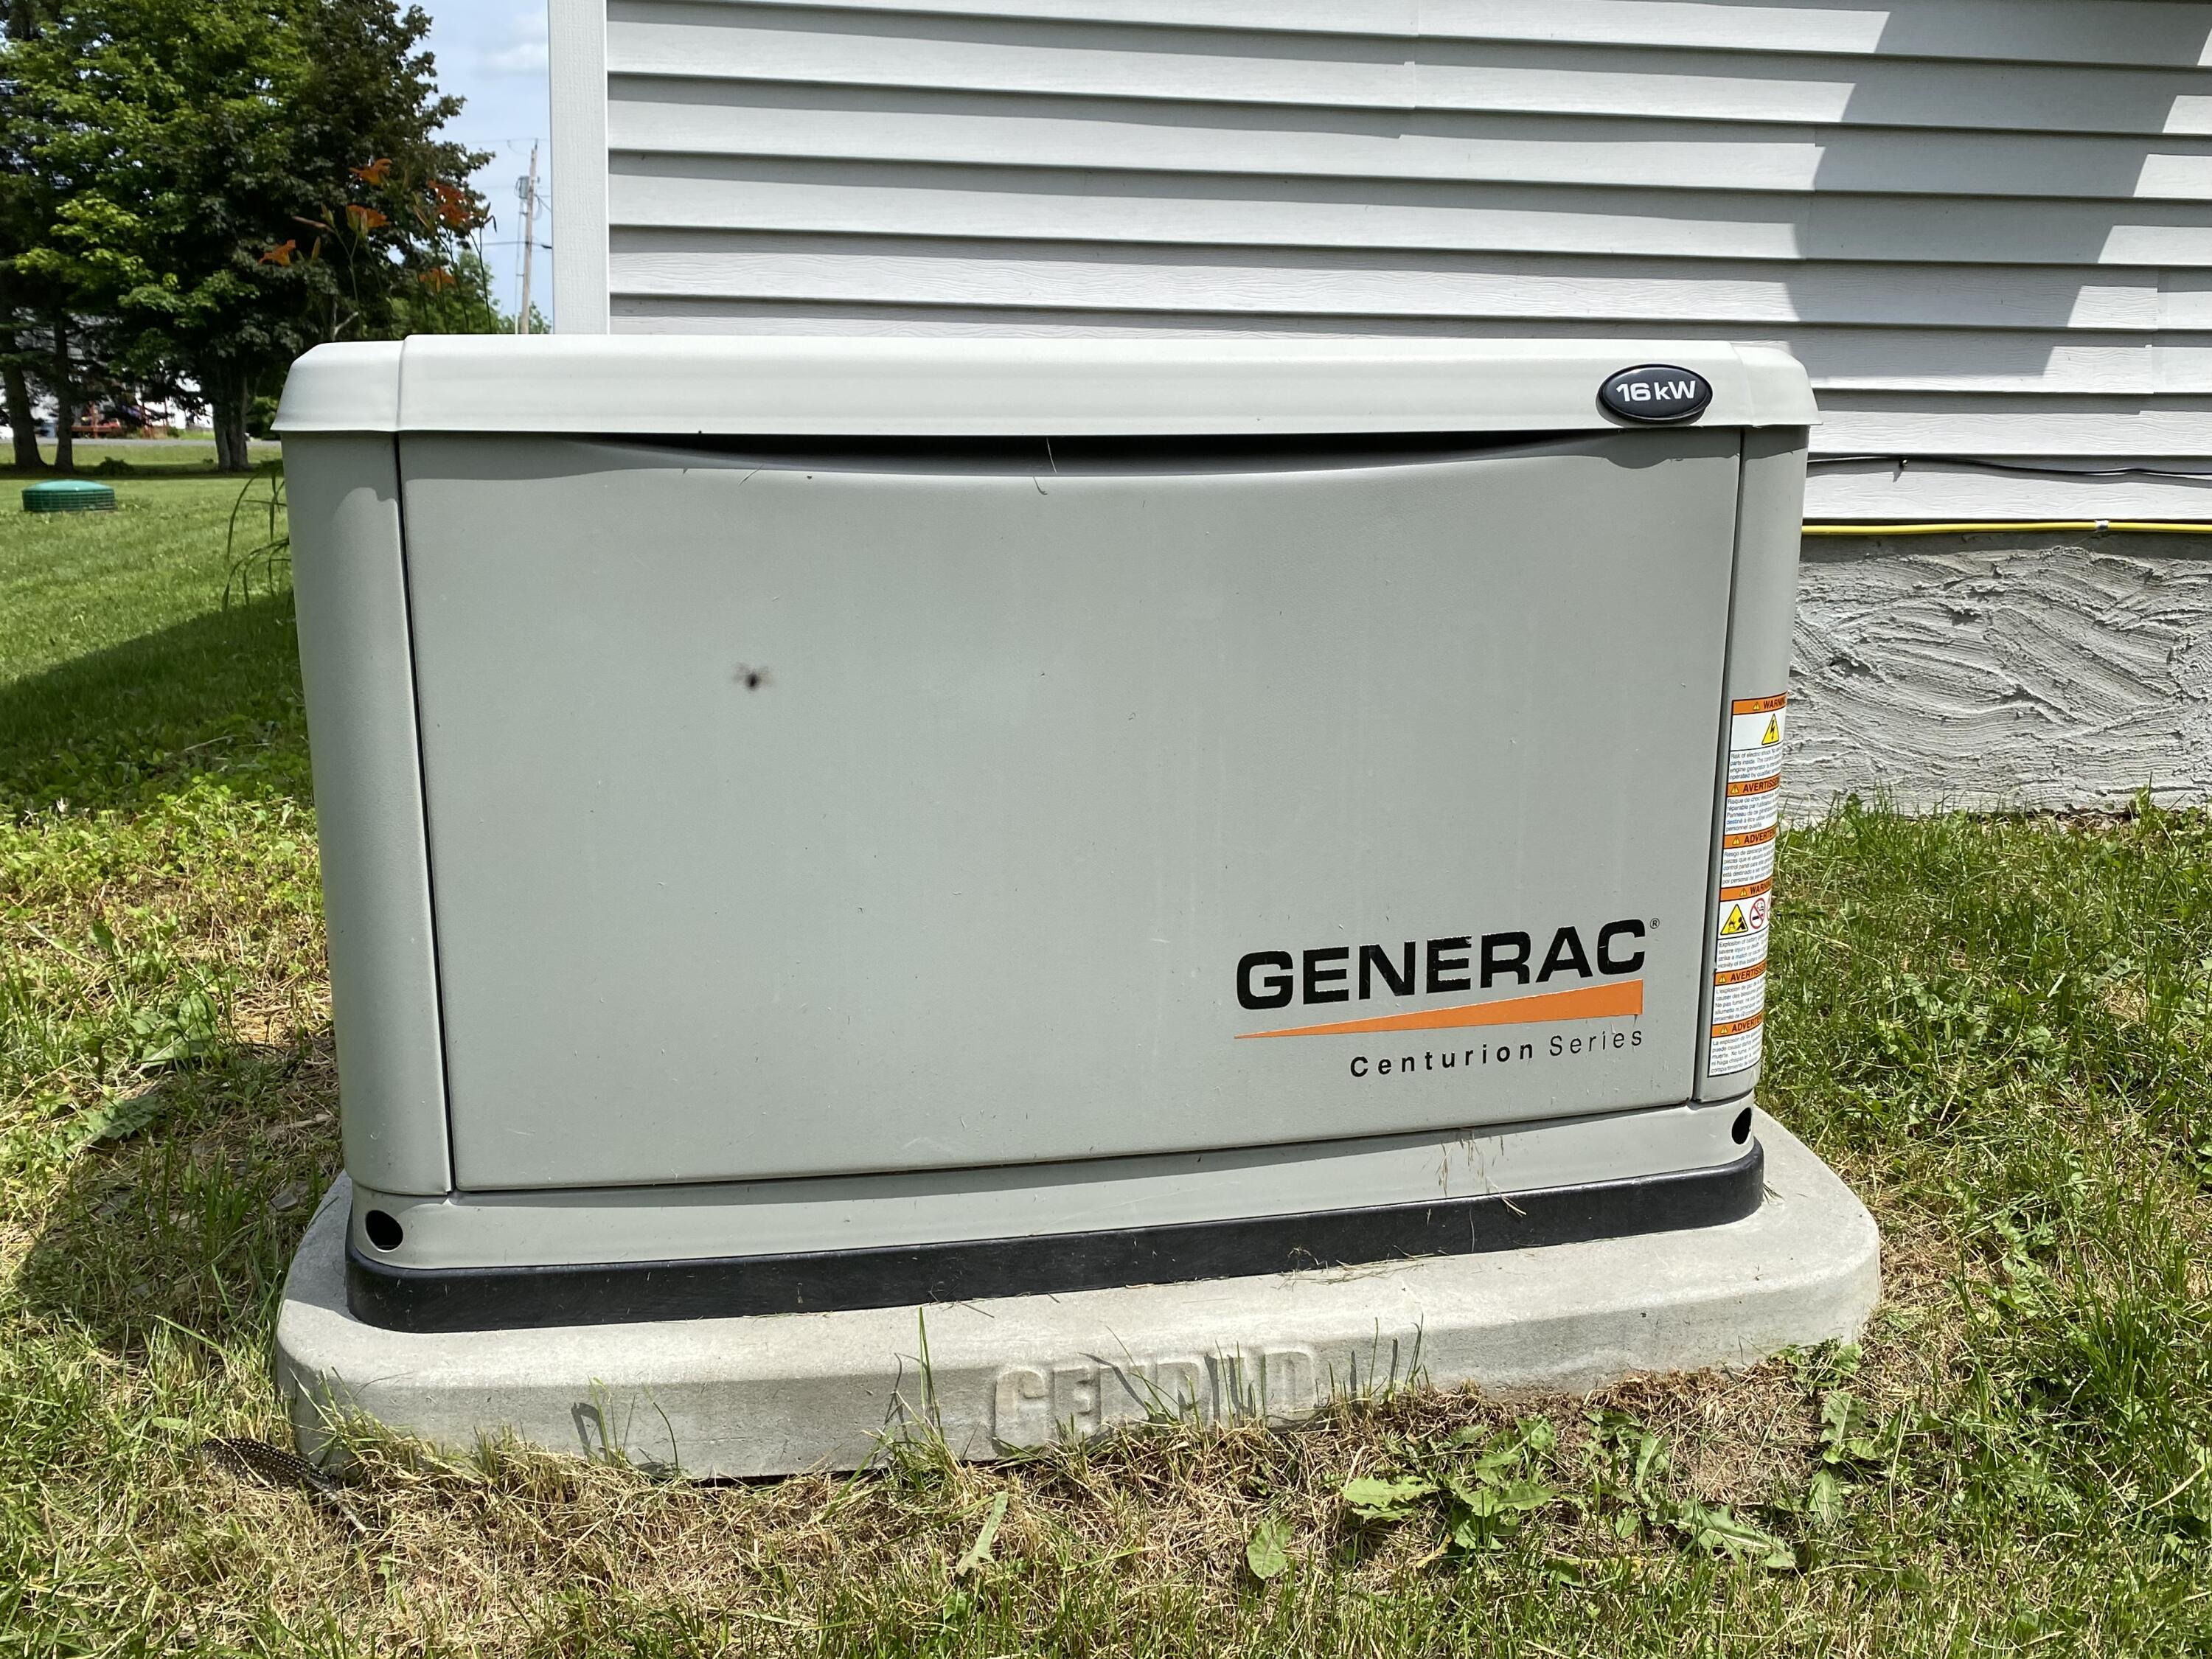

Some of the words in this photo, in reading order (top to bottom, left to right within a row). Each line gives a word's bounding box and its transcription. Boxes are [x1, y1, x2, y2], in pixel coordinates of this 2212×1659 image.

[1616, 383, 1652, 401] 16
[1654, 380, 1696, 400] kW
[1237, 919, 1646, 1010] GENERAC
[1350, 1040, 1533, 1077] Centurion
[1549, 1030, 1642, 1056] Series
